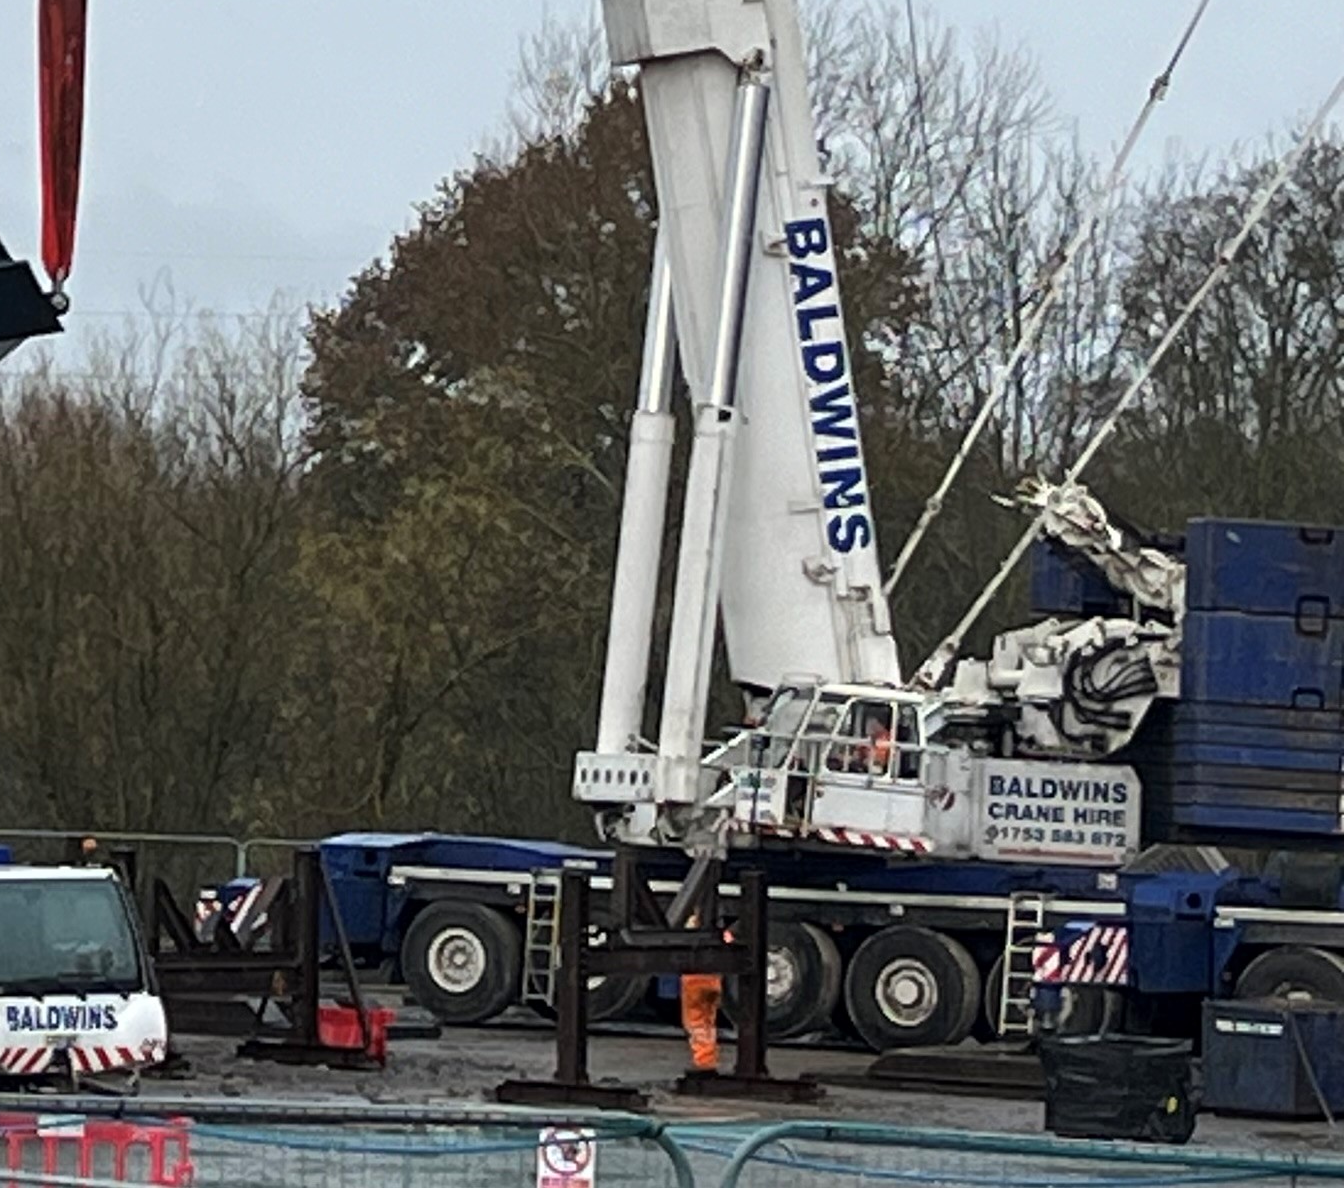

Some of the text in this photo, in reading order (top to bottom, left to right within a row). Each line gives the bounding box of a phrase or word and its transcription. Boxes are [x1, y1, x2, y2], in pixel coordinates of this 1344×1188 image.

[784, 217, 872, 555] BALDWINS
[989, 775, 1128, 804] BALDWINS
[988, 802, 1126, 828] CRANE HIRE
[6, 1004, 119, 1032] BALDWINS
